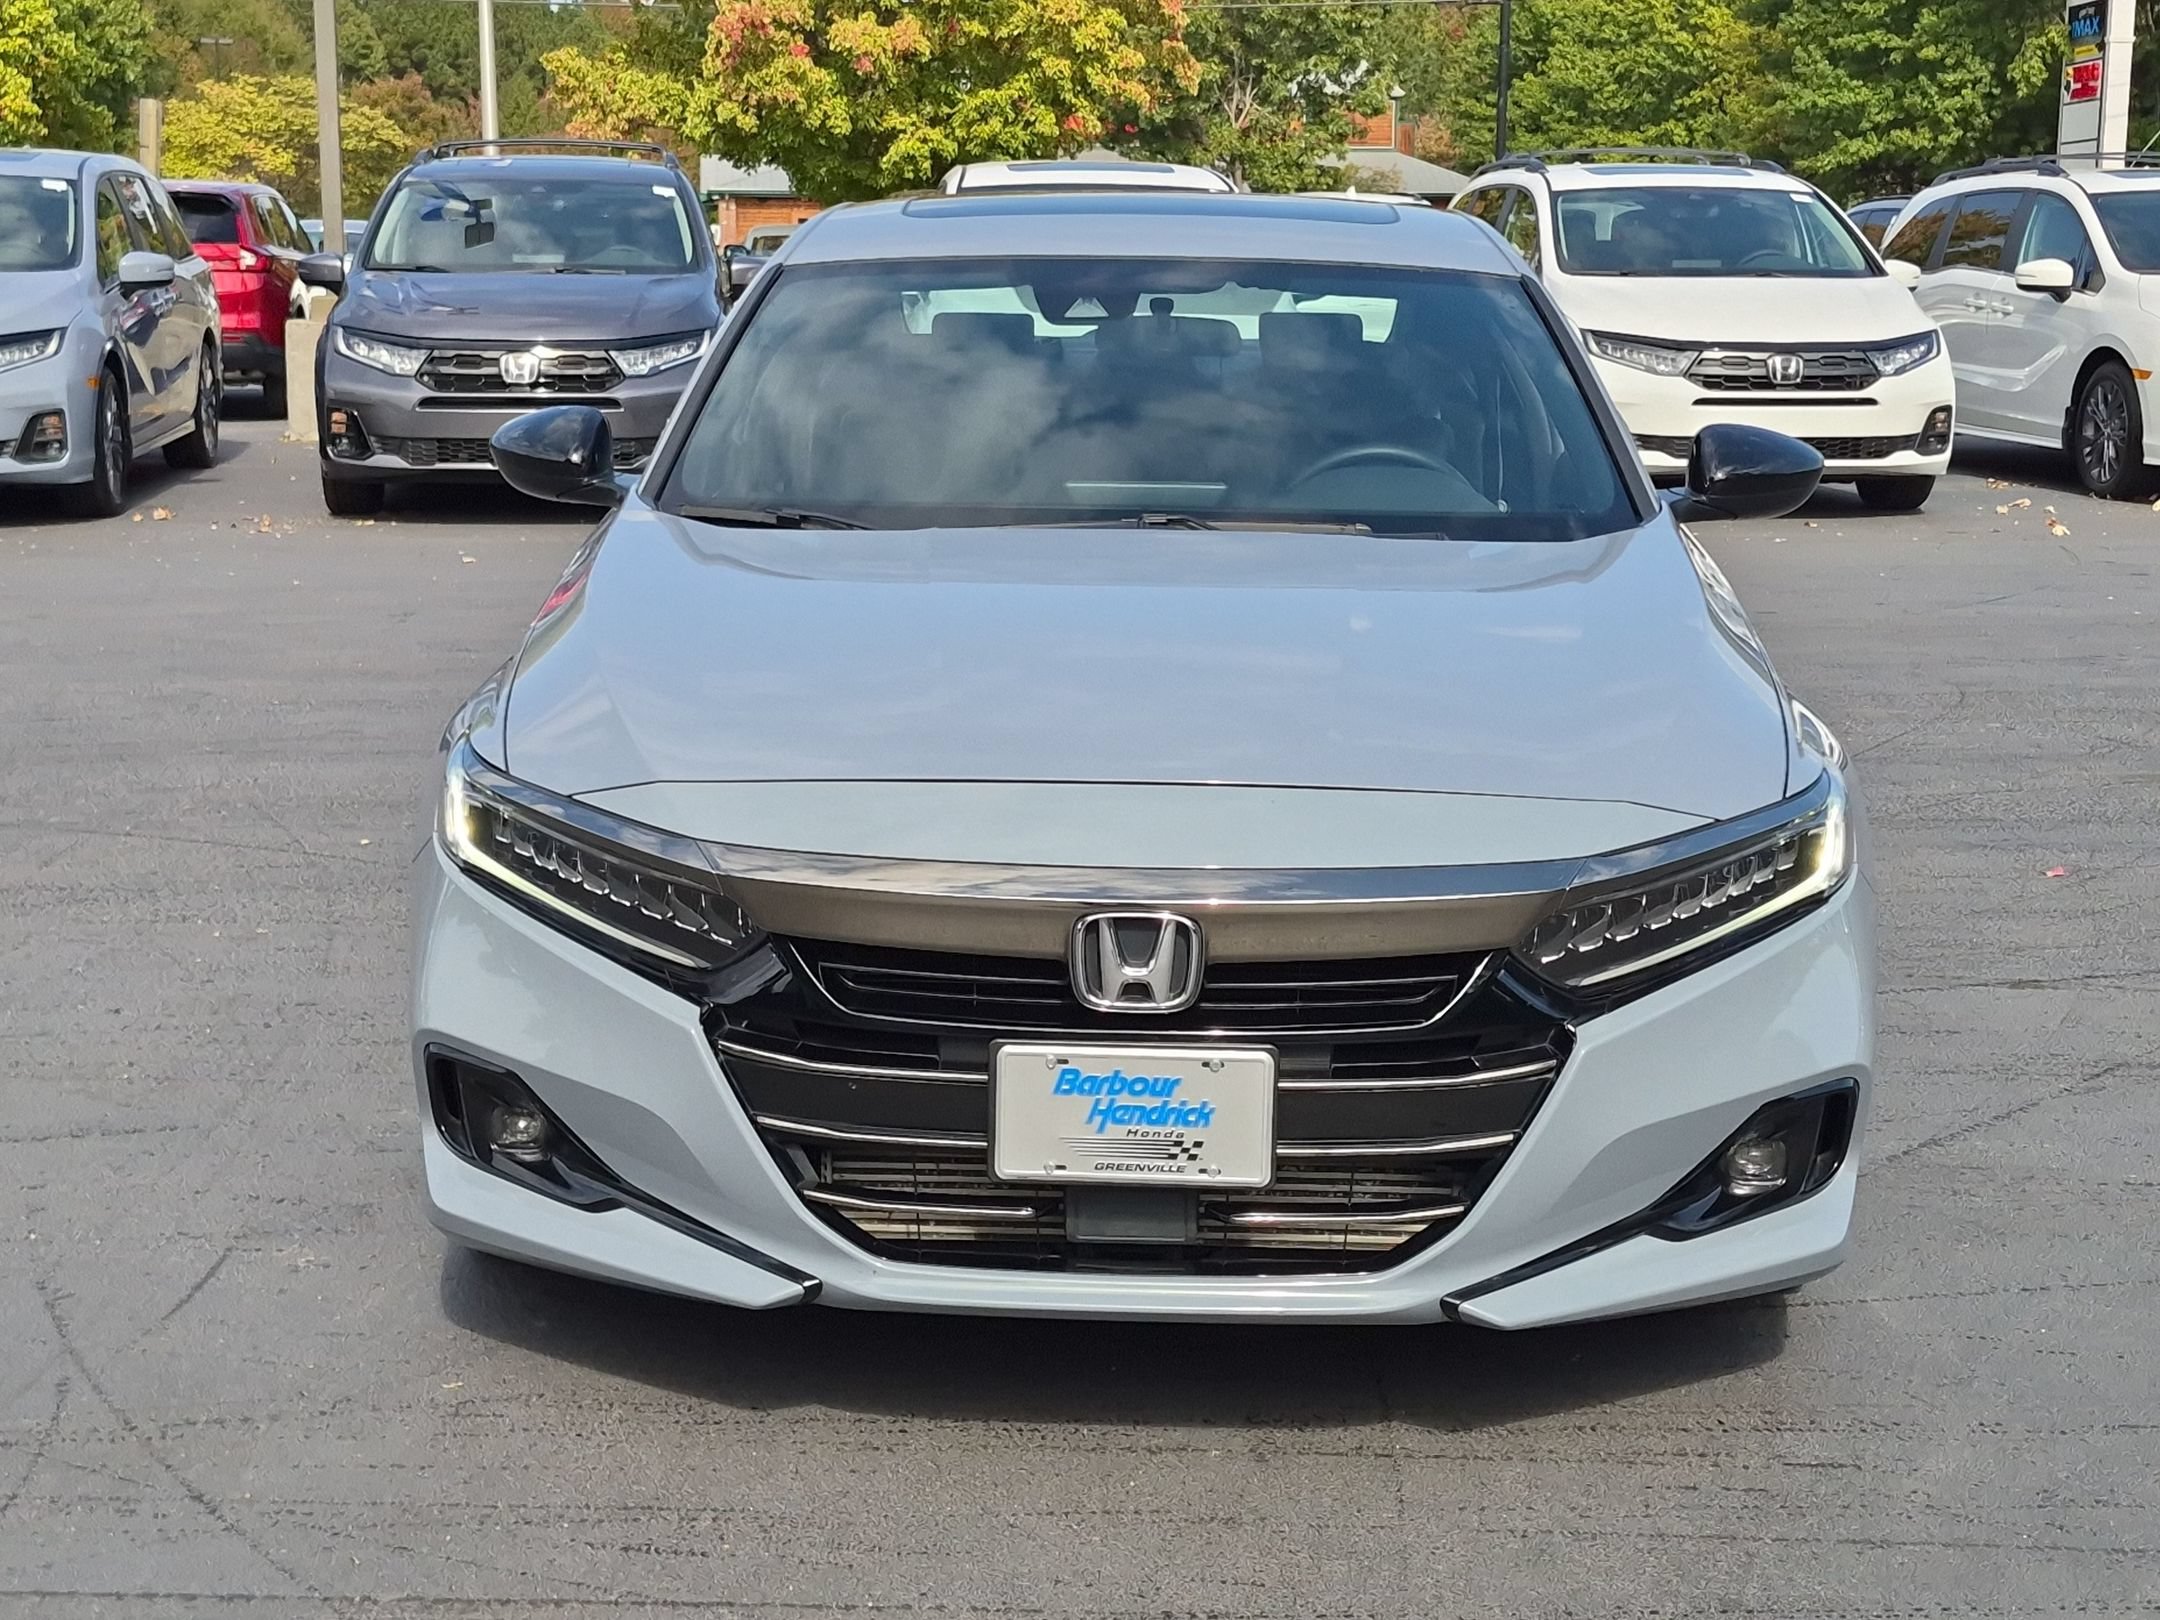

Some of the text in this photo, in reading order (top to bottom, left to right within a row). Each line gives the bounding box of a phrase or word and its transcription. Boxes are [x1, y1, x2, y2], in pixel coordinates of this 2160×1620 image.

[2072, 15, 2100, 38] IMAX
[1053, 1067, 1183, 1098] Barbour
[1085, 1097, 1216, 1134] Hendrick
[1126, 1128, 1186, 1139] Honda
[1094, 1162, 1187, 1174] GREENVILLE
